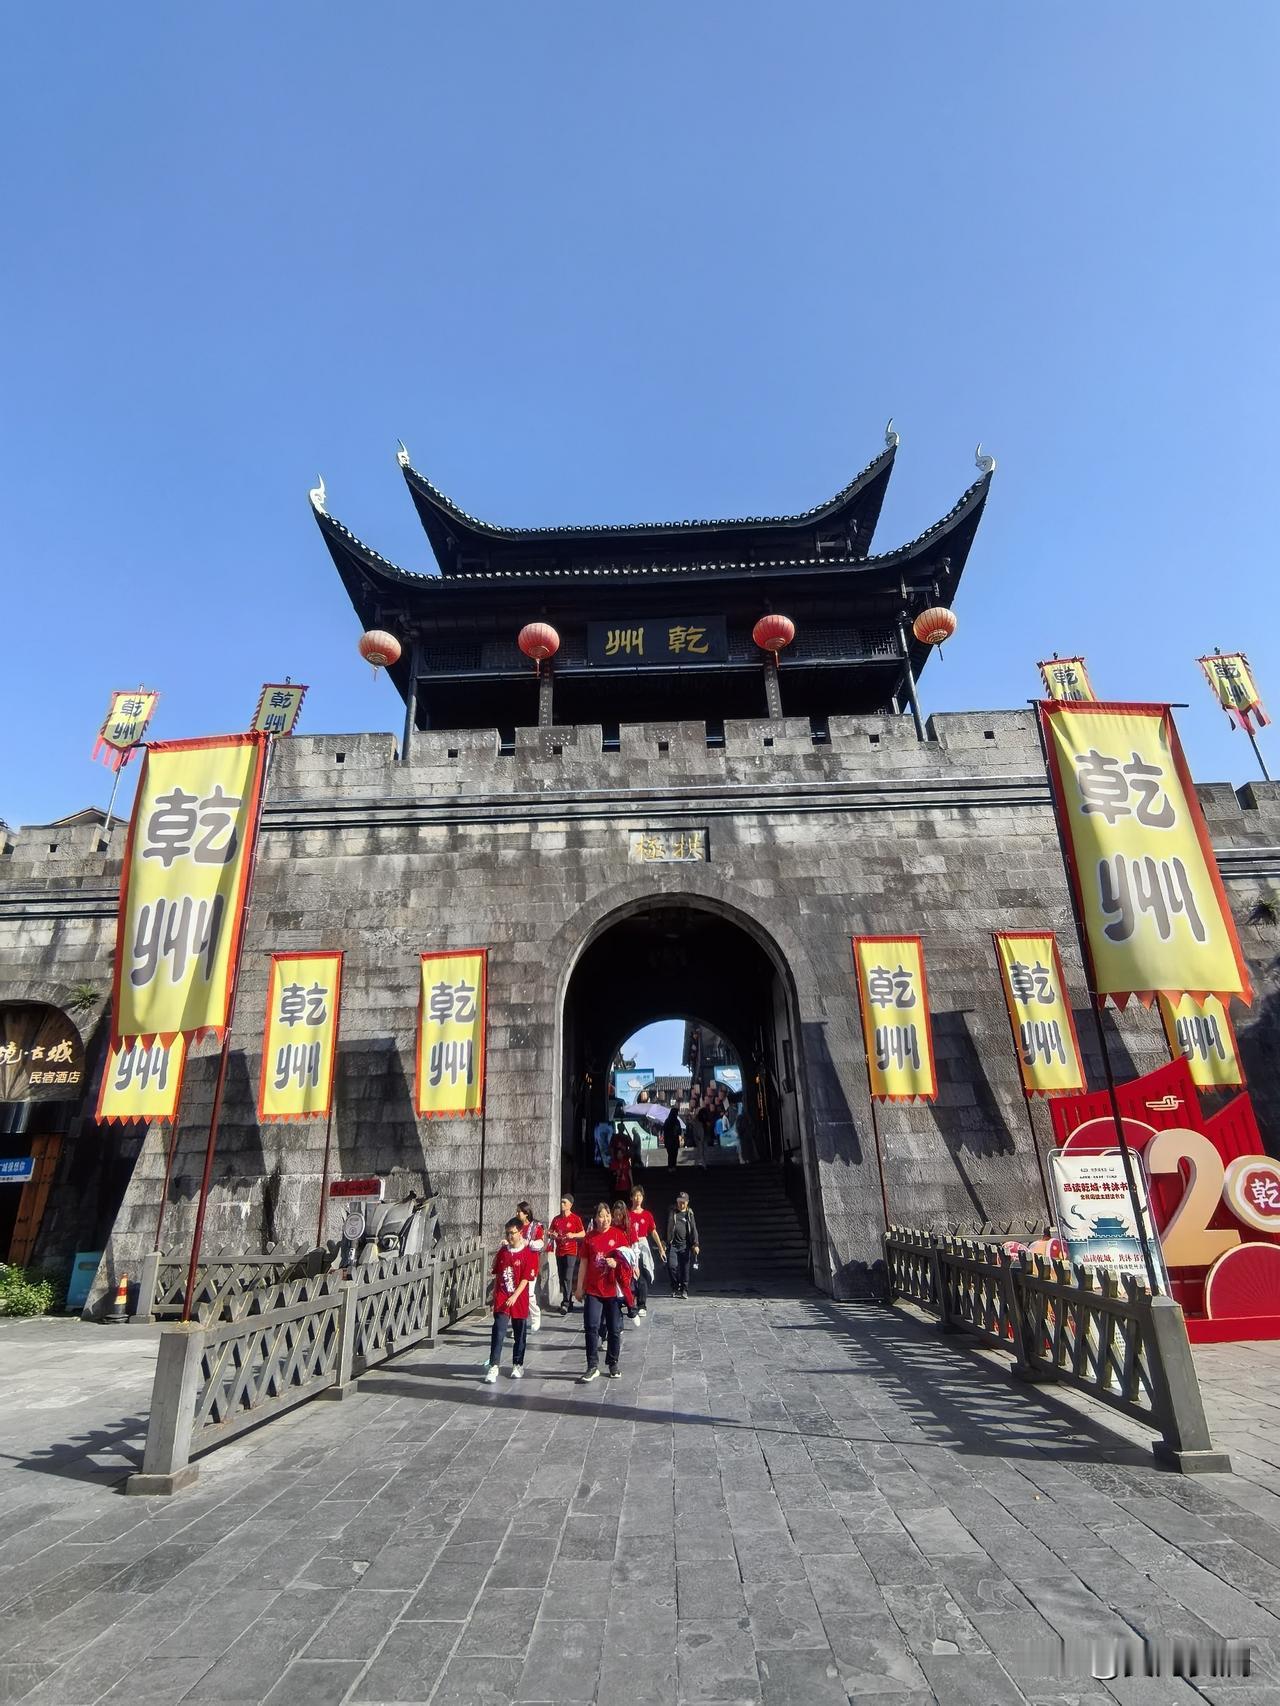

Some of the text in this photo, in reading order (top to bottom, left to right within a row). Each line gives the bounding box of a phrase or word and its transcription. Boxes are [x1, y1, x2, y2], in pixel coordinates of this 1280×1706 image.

[113, 698, 145, 741] 乾州
[263, 691, 294, 732] 乾州
[1212, 662, 1251, 704] 乾州
[131, 785, 241, 988] 乾州
[1075, 750, 1206, 943] 乾州
[274, 981, 328, 1090] 乾州
[429, 980, 477, 1088] 乾州
[869, 965, 921, 1071] 乾州
[1010, 961, 1066, 1067] 乾州
[29, 1071, 81, 1084] 民宿酒店
[1250, 1178, 1280, 1209] 乾
